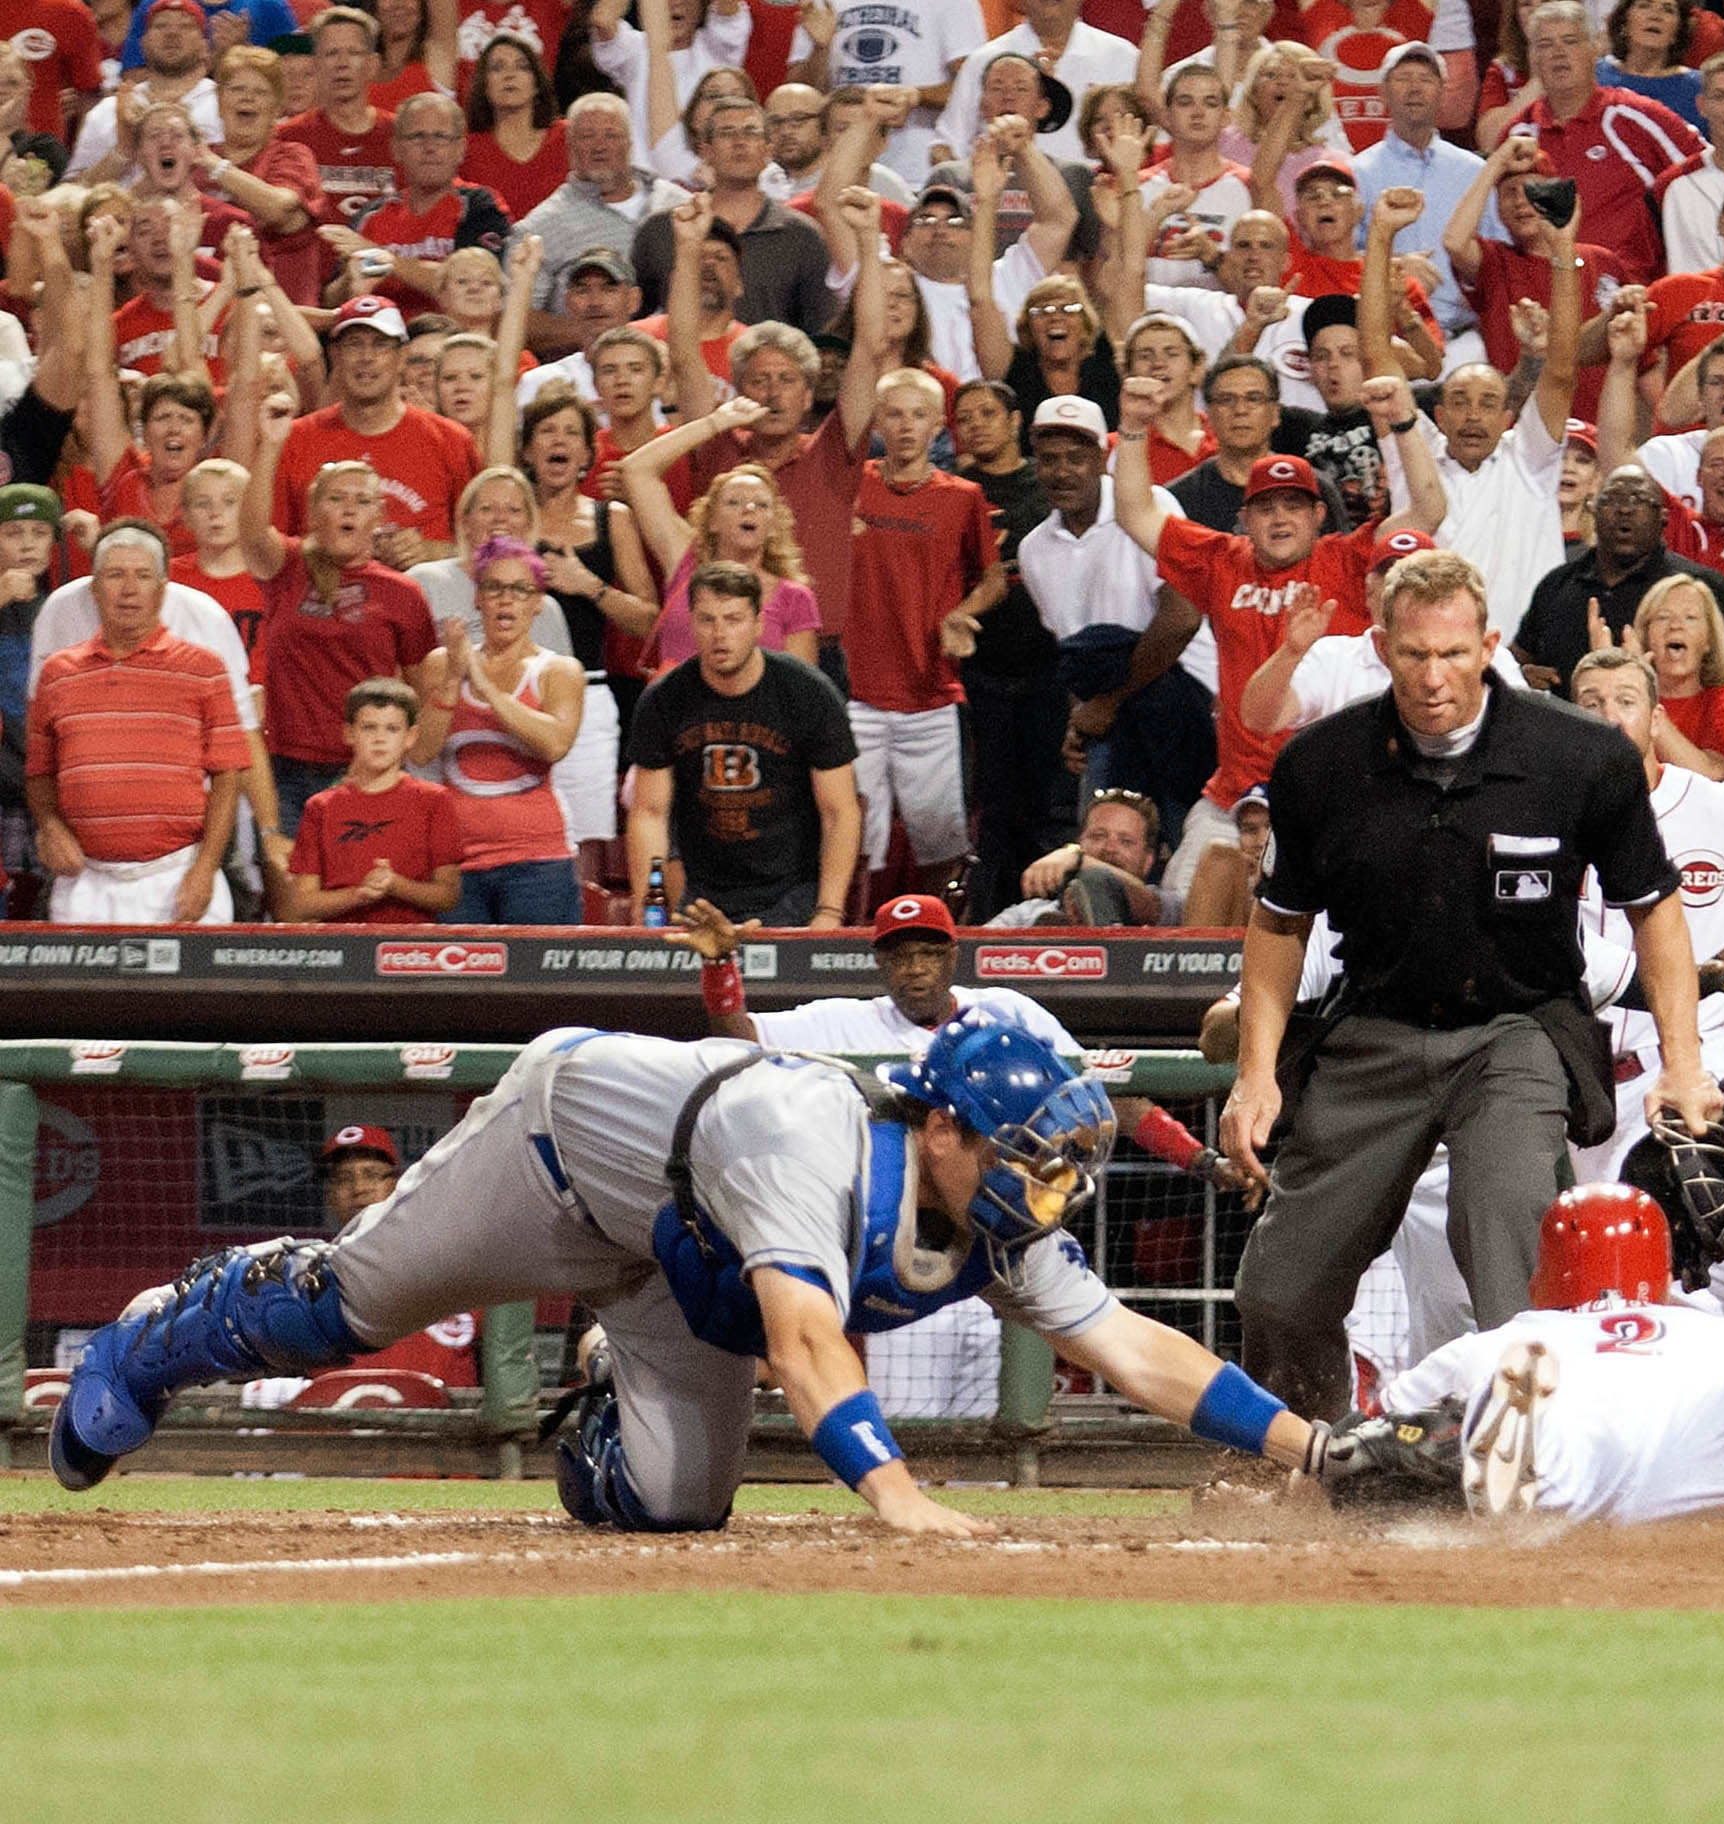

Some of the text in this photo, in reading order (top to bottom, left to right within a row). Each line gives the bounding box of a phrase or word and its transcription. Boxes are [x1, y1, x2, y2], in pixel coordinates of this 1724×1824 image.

[75, 945, 119, 967] FLAG
[541, 949, 703, 972] FLY YOUR OWN FLA
[811, 952, 880, 970] NEWERA
[1143, 952, 1175, 973] FLY
[1177, 952, 1226, 973] YOUR
[1595, 1312, 1667, 1357] 2
